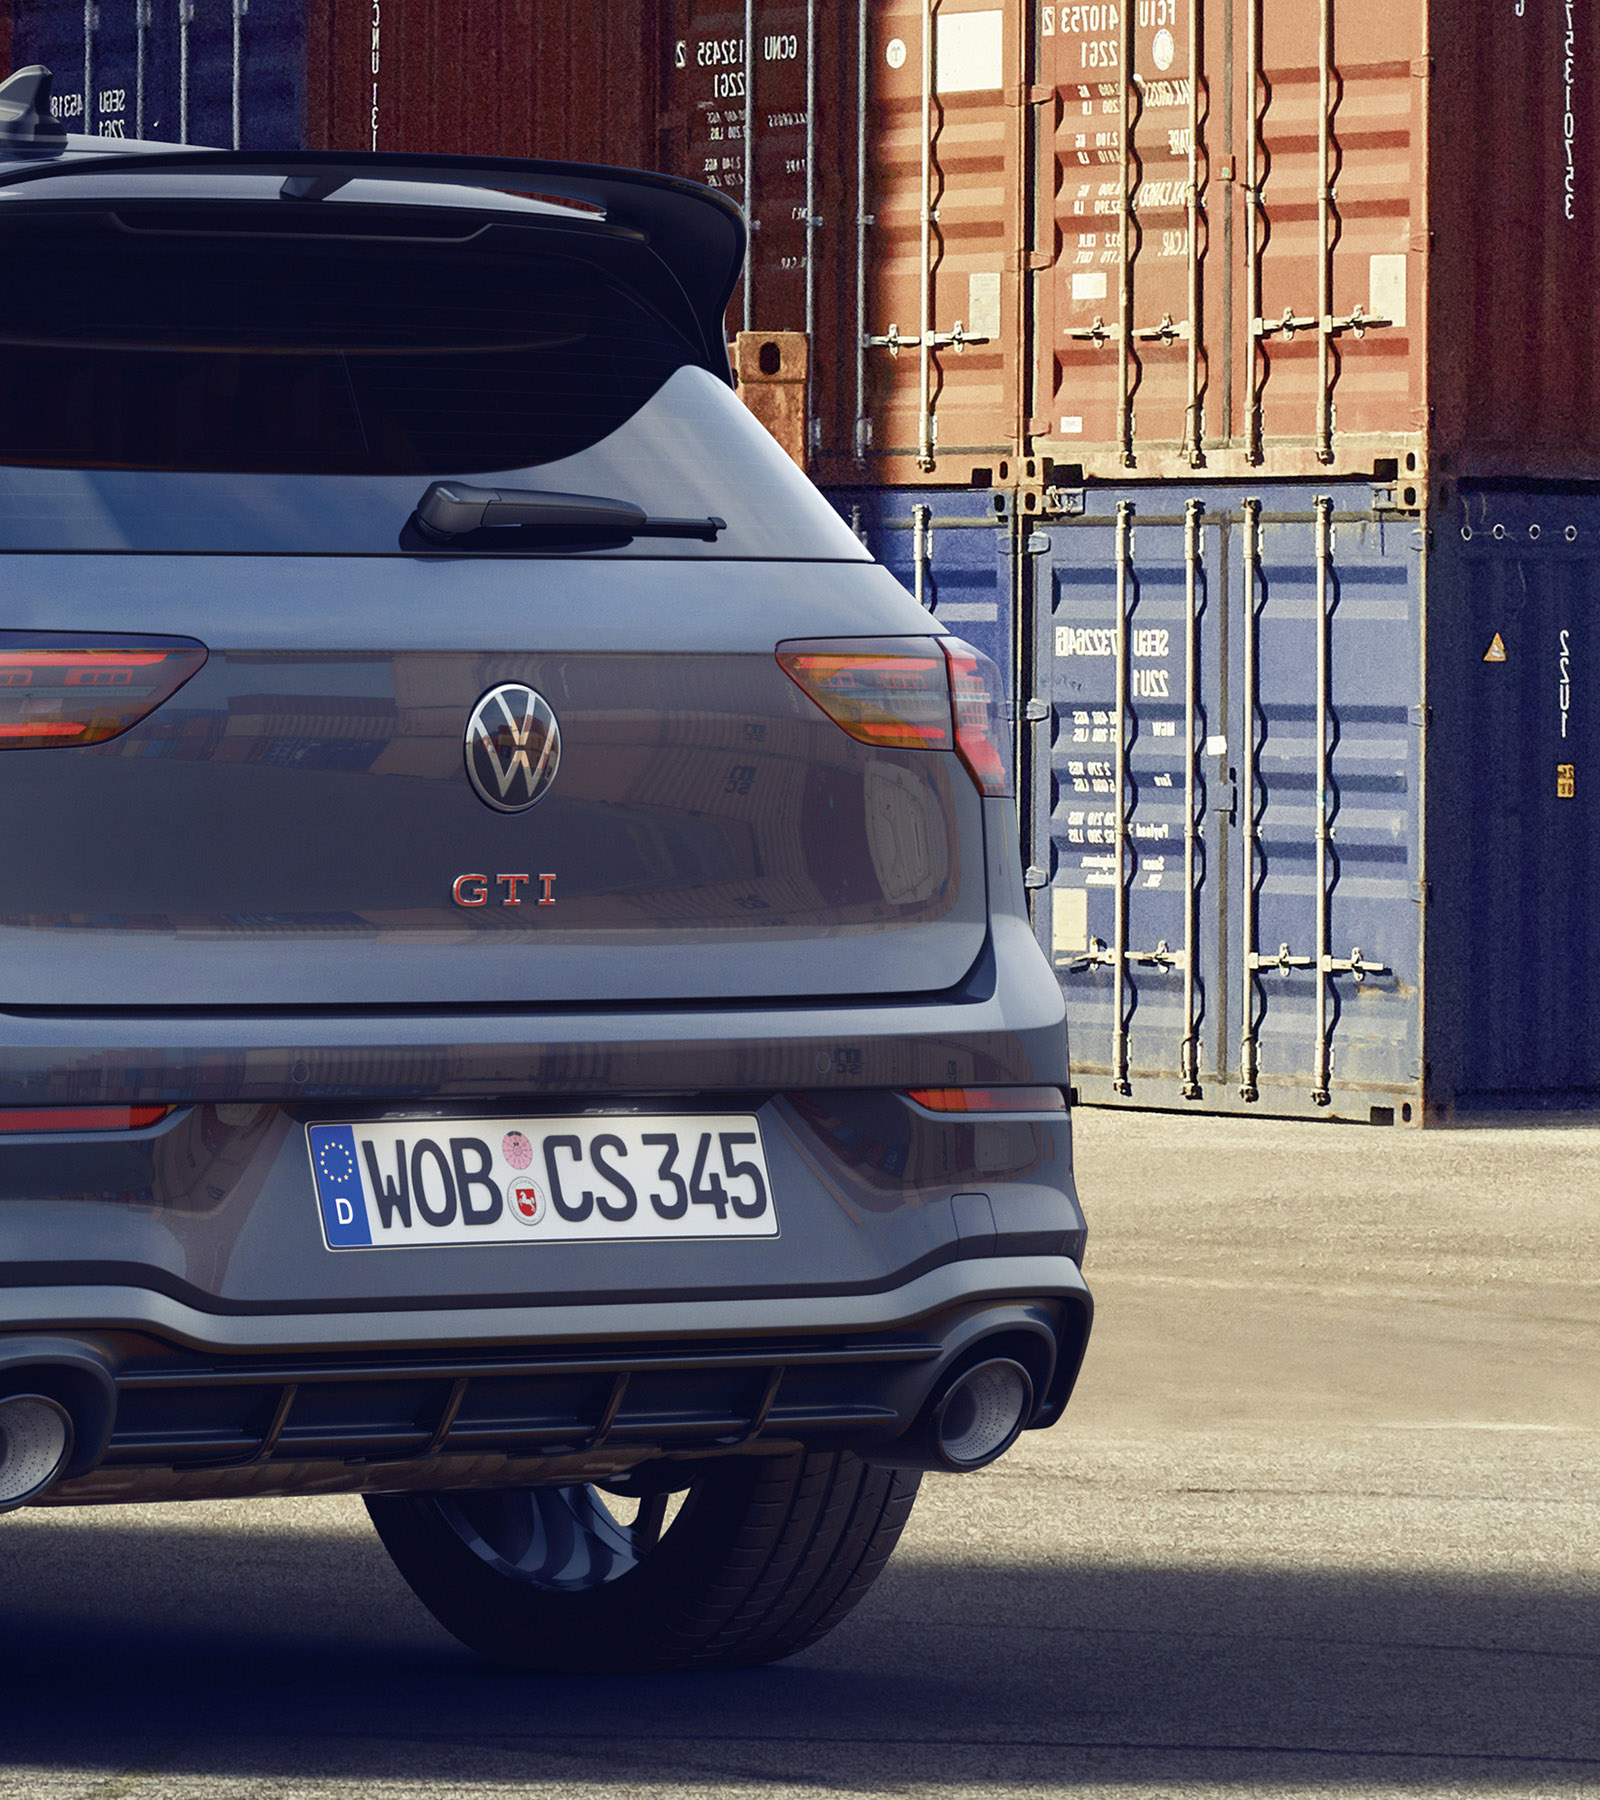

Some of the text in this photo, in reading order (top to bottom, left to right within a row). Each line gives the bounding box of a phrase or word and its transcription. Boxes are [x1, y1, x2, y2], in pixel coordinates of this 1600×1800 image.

[452, 873, 557, 906] GTI
[362, 1136, 503, 1229] WOB
[543, 1133, 637, 1222] CS
[641, 1132, 767, 1221] 345
[335, 1198, 353, 1225] D
